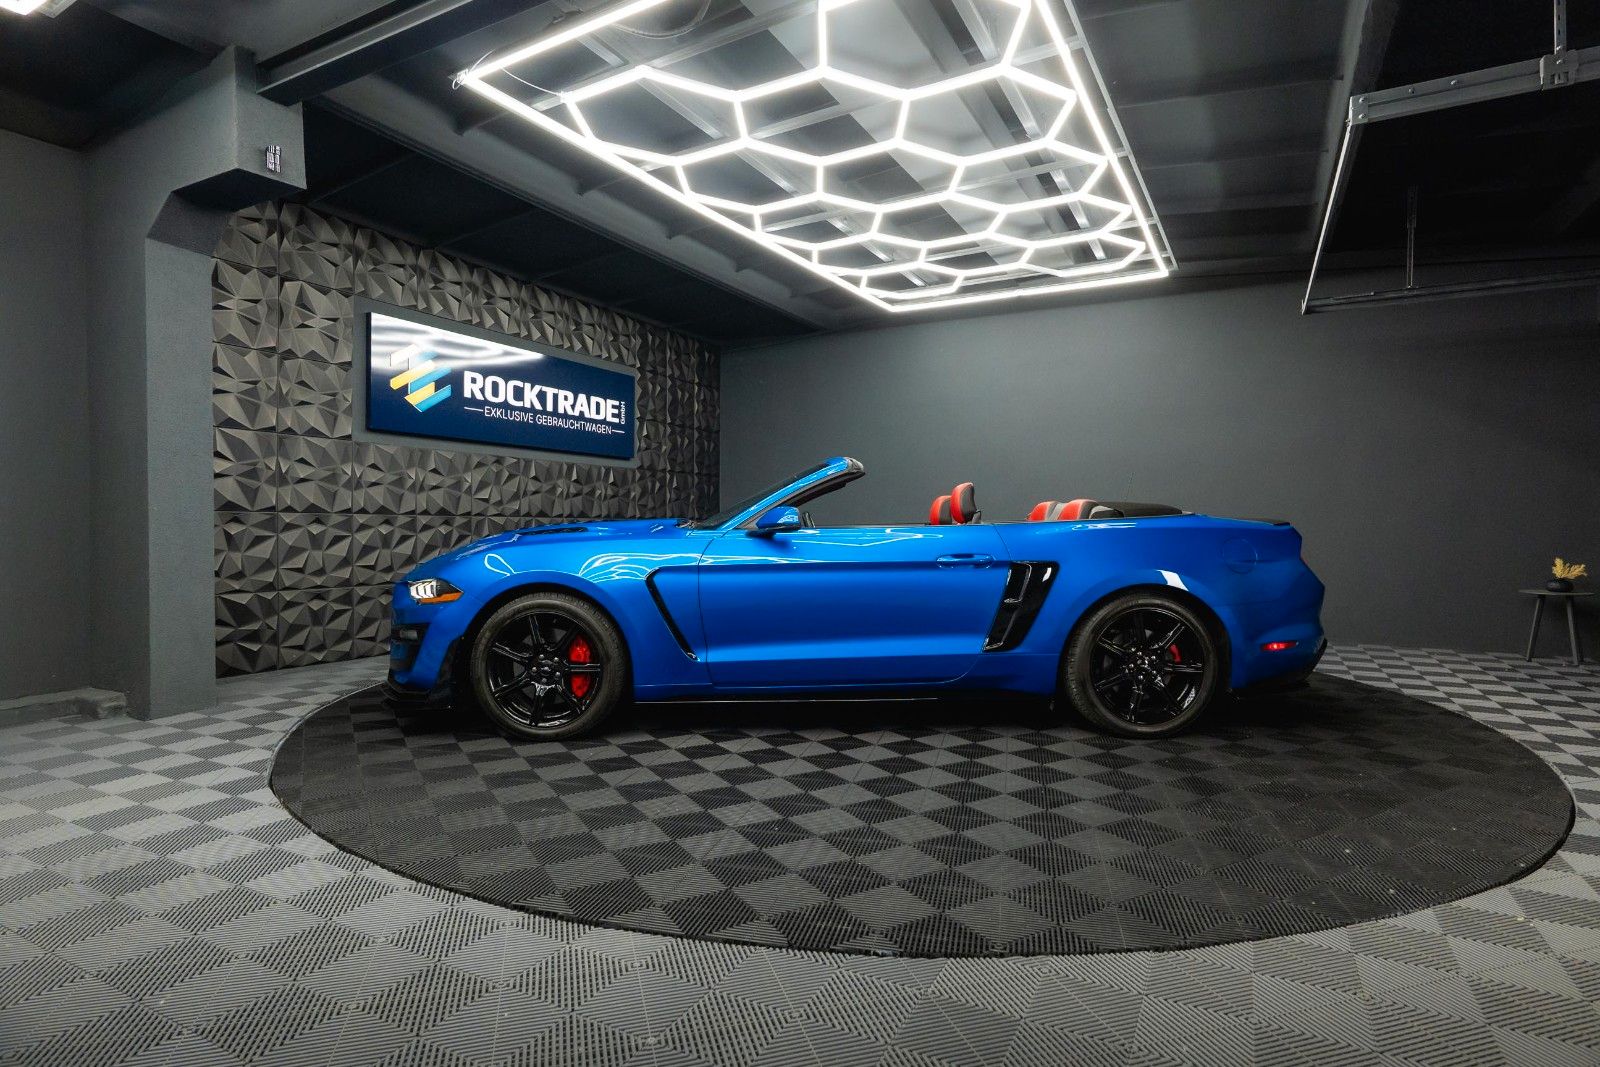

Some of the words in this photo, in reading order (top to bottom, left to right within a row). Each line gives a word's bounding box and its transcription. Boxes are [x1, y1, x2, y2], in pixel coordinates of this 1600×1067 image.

[463, 370, 620, 424] ROCKTRADE
[484, 406, 534, 424] EXKLUSIVE
[535, 414, 612, 435] GEBRAUCHTWAGEN
